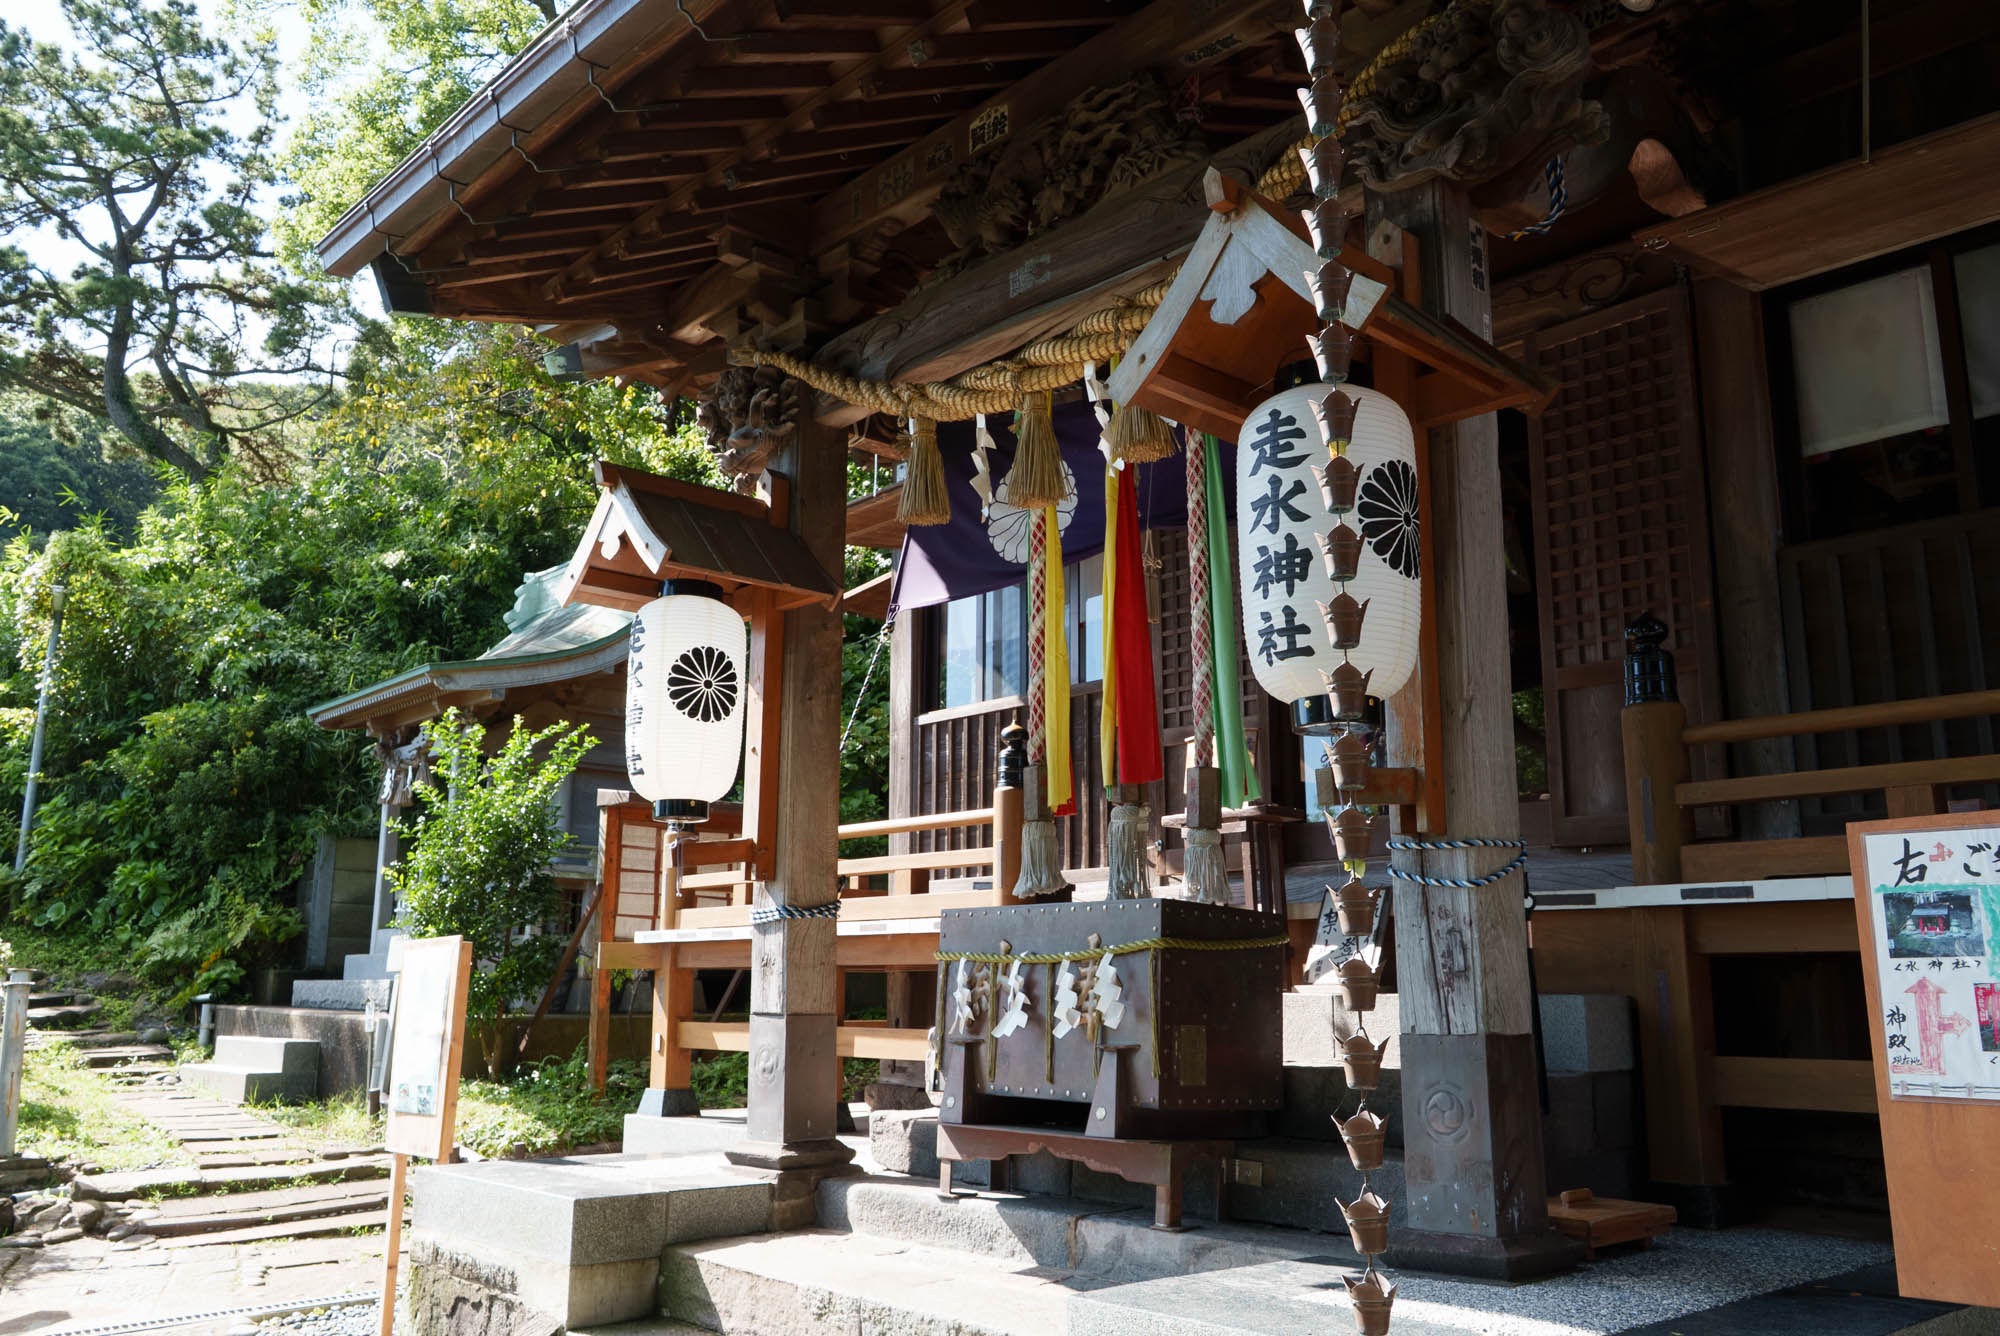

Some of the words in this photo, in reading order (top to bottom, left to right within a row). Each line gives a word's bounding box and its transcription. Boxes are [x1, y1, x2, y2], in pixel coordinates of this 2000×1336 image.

[1248, 408, 1315, 668] 走水神社
[1893, 838, 1928, 887] 右
[1963, 842, 2000, 877] ご
